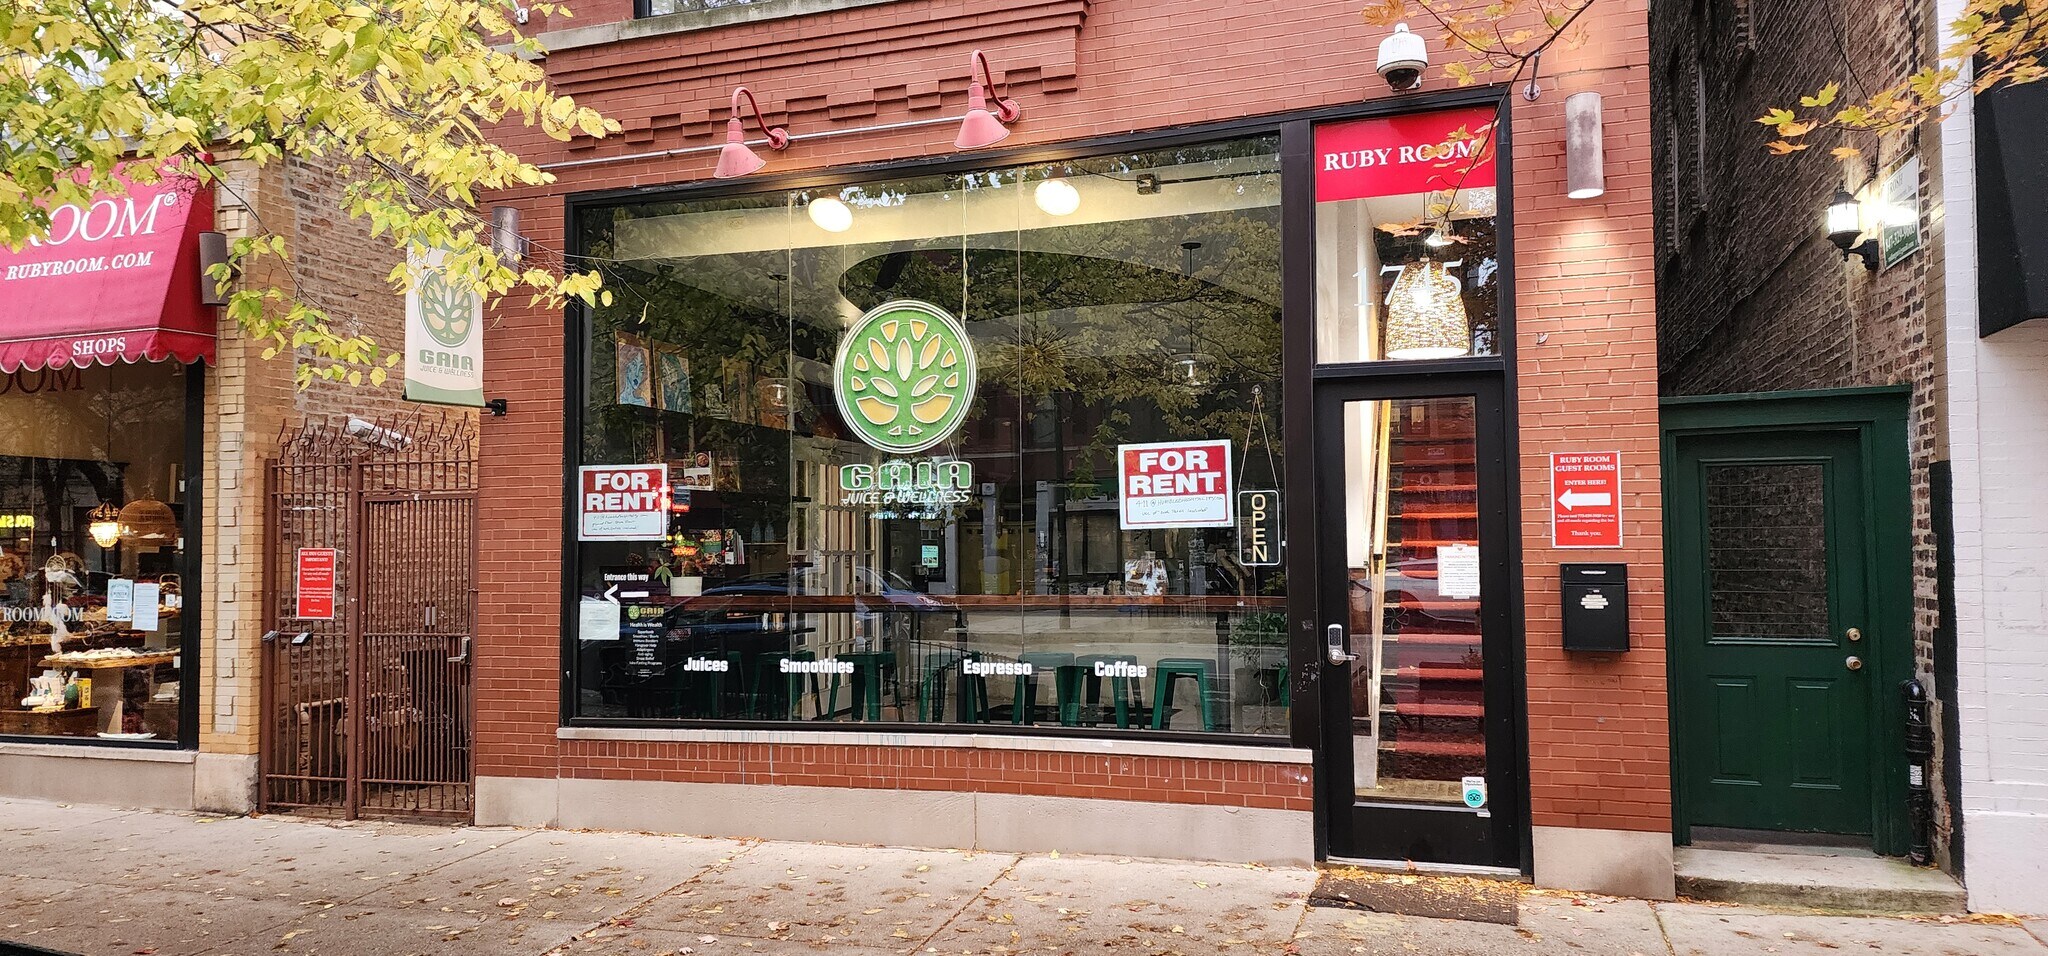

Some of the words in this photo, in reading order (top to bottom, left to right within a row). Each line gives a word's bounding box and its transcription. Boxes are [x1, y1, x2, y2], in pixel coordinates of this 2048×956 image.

[1324, 147, 1392, 171] RUBY
[5, 251, 154, 281] RUBYROOM.COM
[1352, 257, 1464, 308] 1745
[72, 336, 126, 356] SHOPS
[419, 349, 475, 371] GAIA
[420, 366, 437, 374] JUICE
[444, 369, 475, 378] WELLNESS
[1138, 449, 1209, 473] FOR
[1559, 456, 1582, 464] RUBY
[1583, 455, 1611, 463] ROOM
[1584, 464, 1616, 472] ROOMS
[594, 472, 650, 491] FOR
[840, 461, 973, 491] GAIA
[1129, 471, 1222, 495] RENT
[586, 491, 659, 511] RENT
[841, 492, 881, 505] JUICE
[883, 492, 897, 505] &
[896, 490, 972, 504] WELLNESS
[1251, 493, 1268, 563] OPEN
[604, 573, 627, 581] Entrance
[627, 572, 638, 581] this
[638, 574, 649, 582] way
[640, 607, 665, 615] GAIA
[684, 657, 728, 672] Juices
[779, 658, 855, 674] Smoothies
[963, 659, 1033, 676] Espresso
[1094, 661, 1148, 678] Coffee
